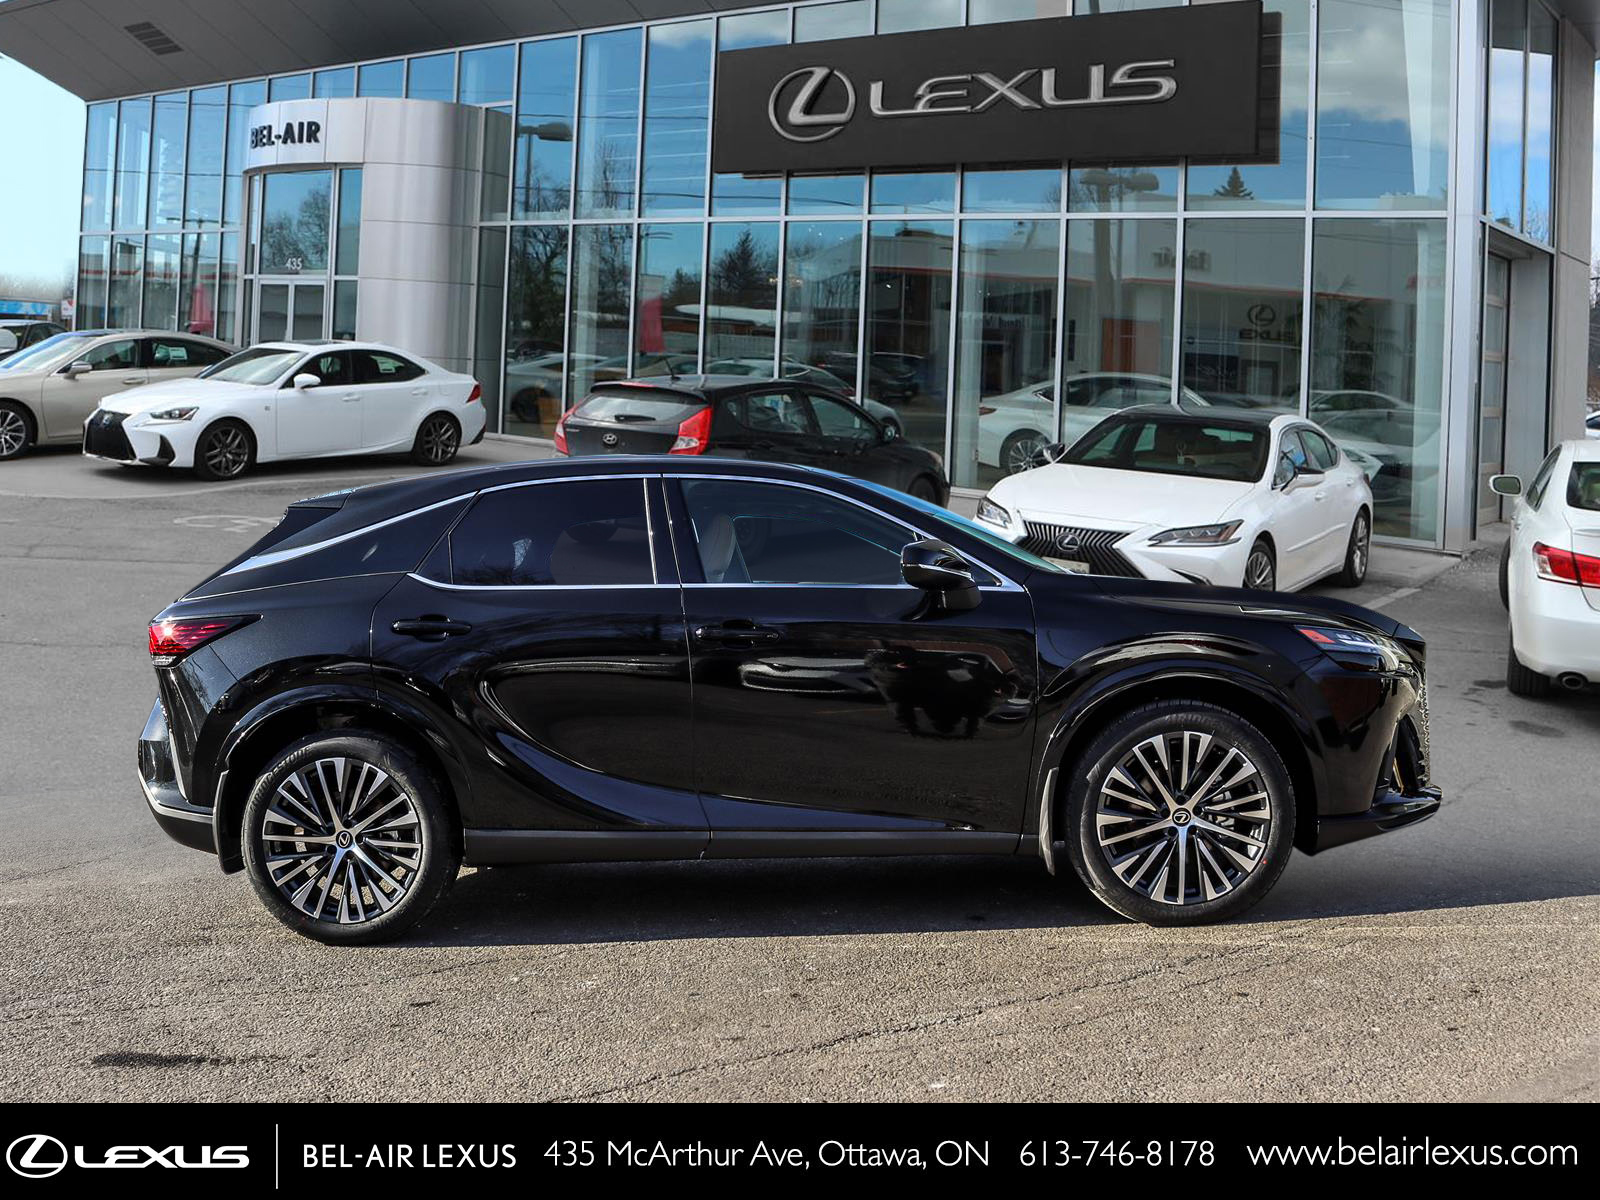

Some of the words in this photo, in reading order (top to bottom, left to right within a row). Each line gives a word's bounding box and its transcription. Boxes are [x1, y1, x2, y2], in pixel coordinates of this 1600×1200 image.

[869, 59, 1177, 117] LEXUS
[250, 121, 321, 149] BEL-AIR
[286, 257, 303, 270] 435
